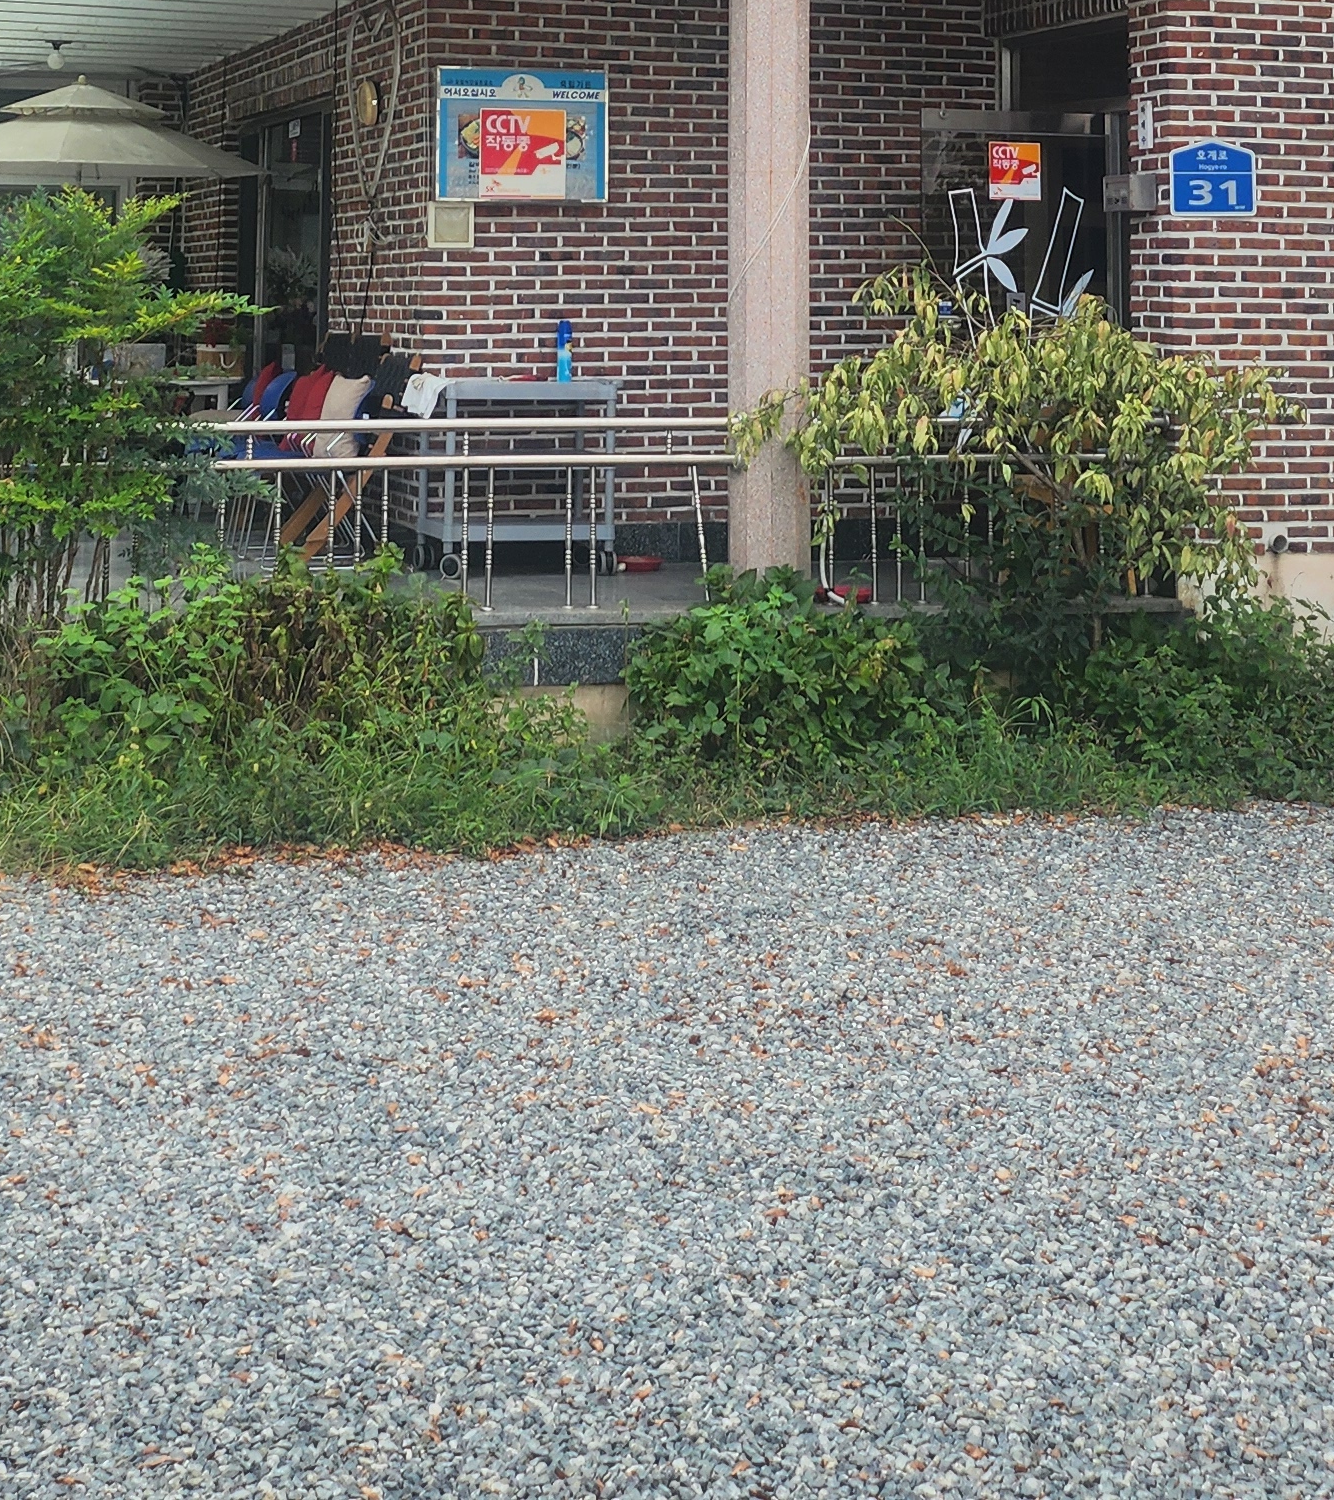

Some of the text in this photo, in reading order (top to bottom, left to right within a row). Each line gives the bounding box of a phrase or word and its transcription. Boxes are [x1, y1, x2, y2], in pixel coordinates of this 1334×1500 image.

[443, 87, 497, 98] 어서오십시오
[552, 90, 601, 100] WELCOME
[485, 114, 531, 134] CCTV
[485, 135, 531, 152] 작동중
[992, 145, 1020, 159] CCTV
[1195, 149, 1229, 161] 호계로
[1198, 163, 1228, 171] Hogye-ro
[1188, 179, 1238, 206] 31
